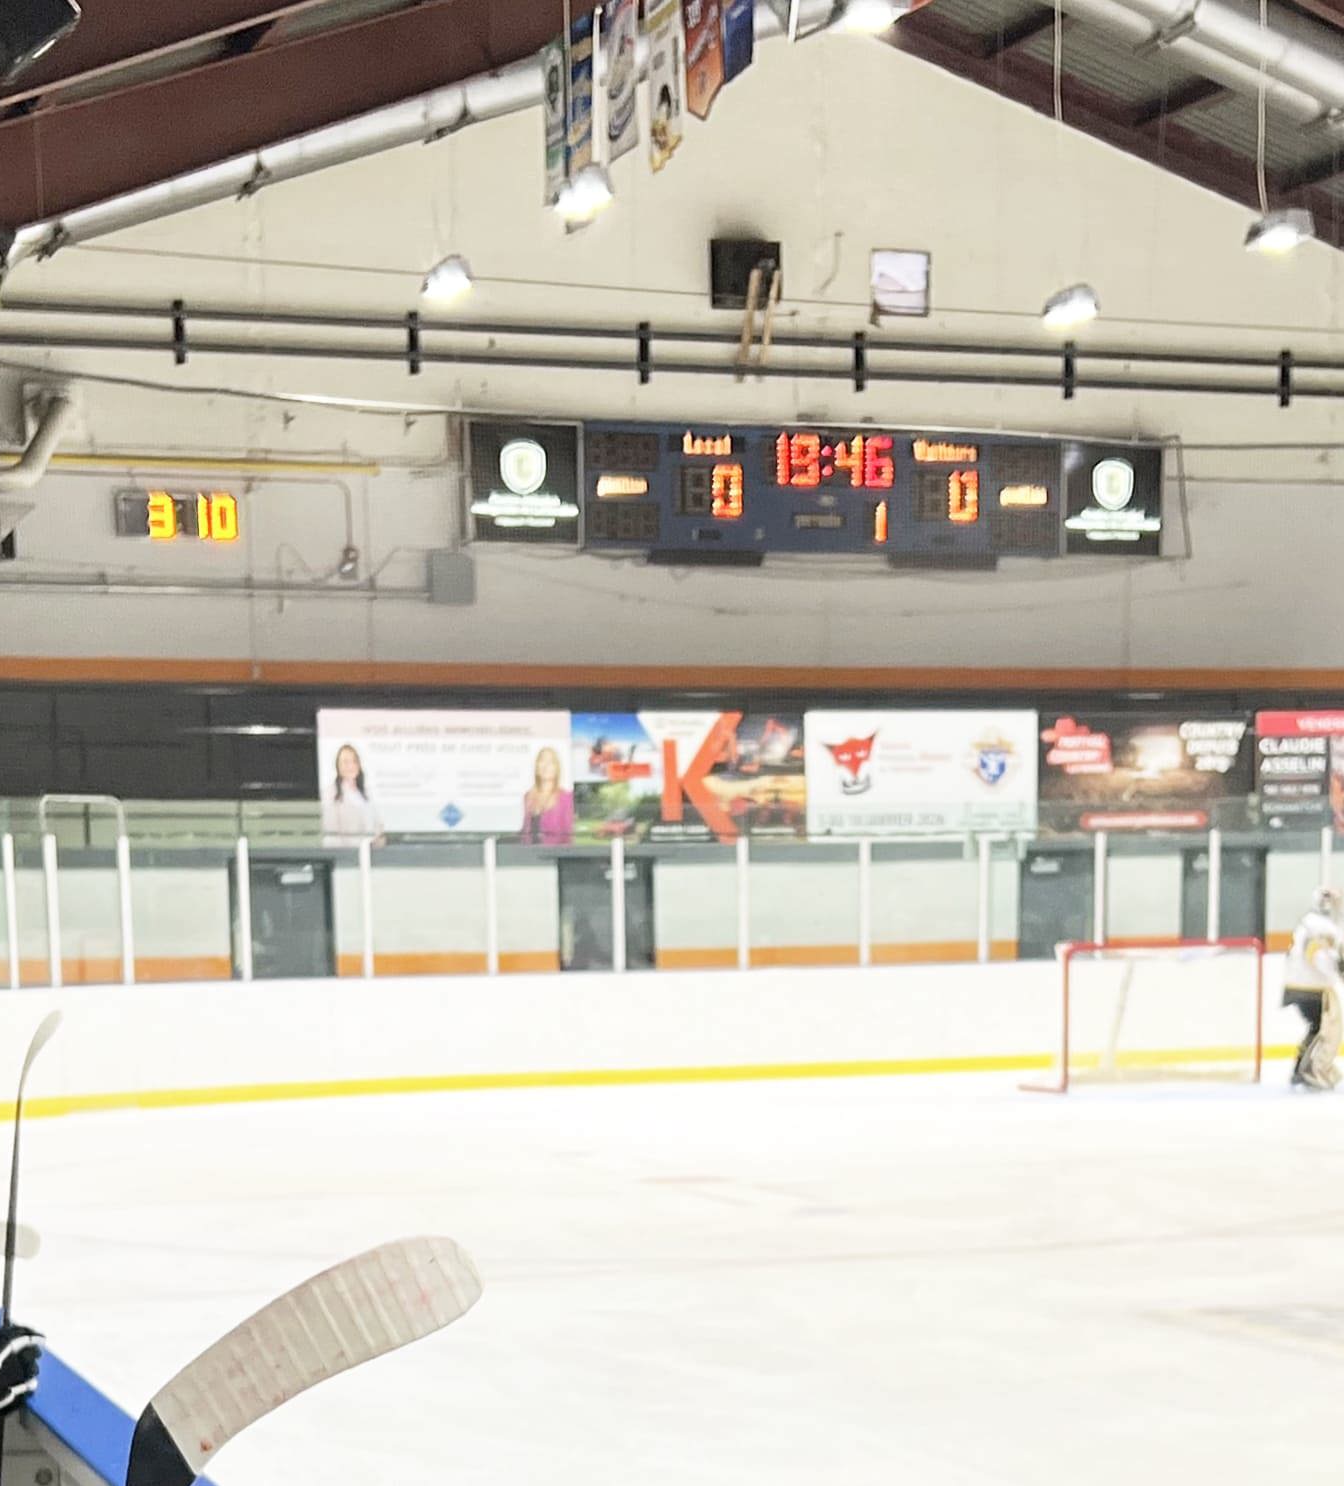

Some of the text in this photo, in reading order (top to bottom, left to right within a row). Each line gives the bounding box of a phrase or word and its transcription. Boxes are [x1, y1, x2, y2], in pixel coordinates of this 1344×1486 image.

[776, 431, 894, 488] 19:46
[712, 464, 743, 517] 0
[949, 470, 978, 522] 0
[875, 501, 888, 544] 1
